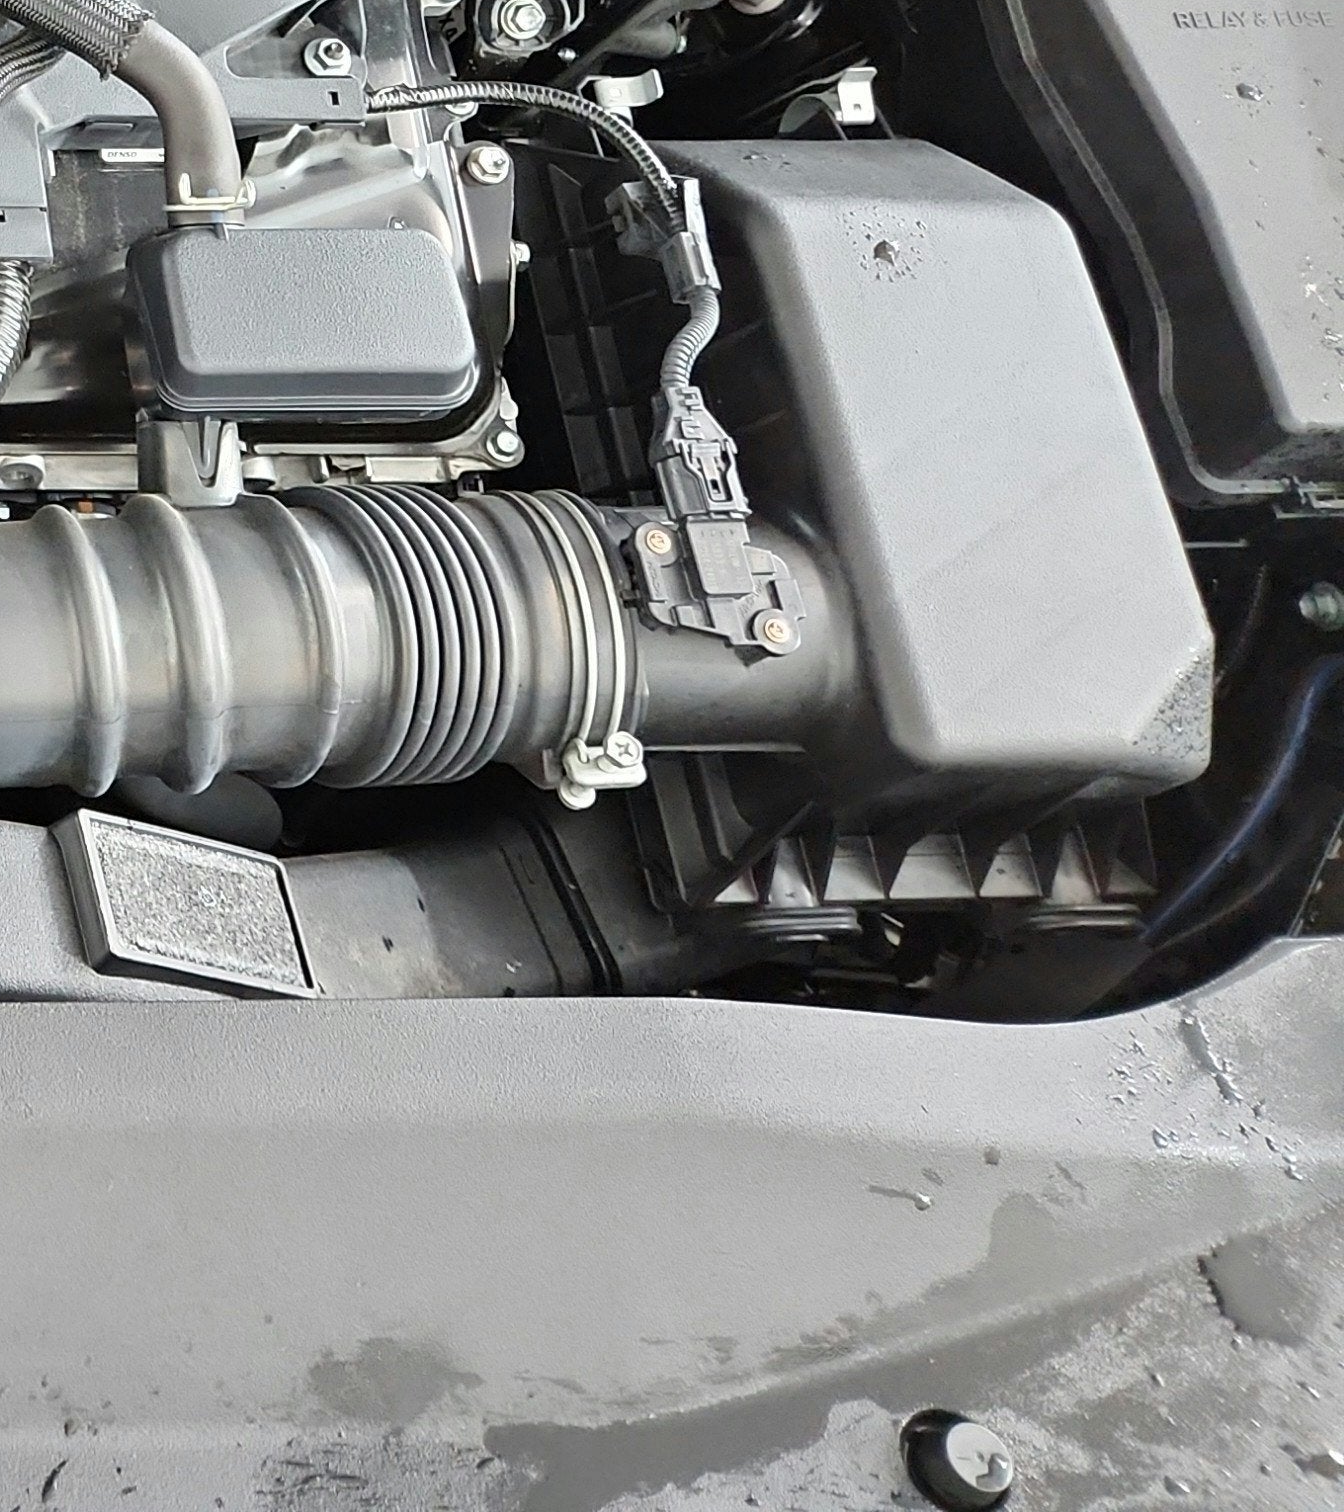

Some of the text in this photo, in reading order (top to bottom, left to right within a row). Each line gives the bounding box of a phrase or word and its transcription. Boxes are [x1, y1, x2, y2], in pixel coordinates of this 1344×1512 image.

[1172, 9, 1335, 29] RELAY & FUSE
